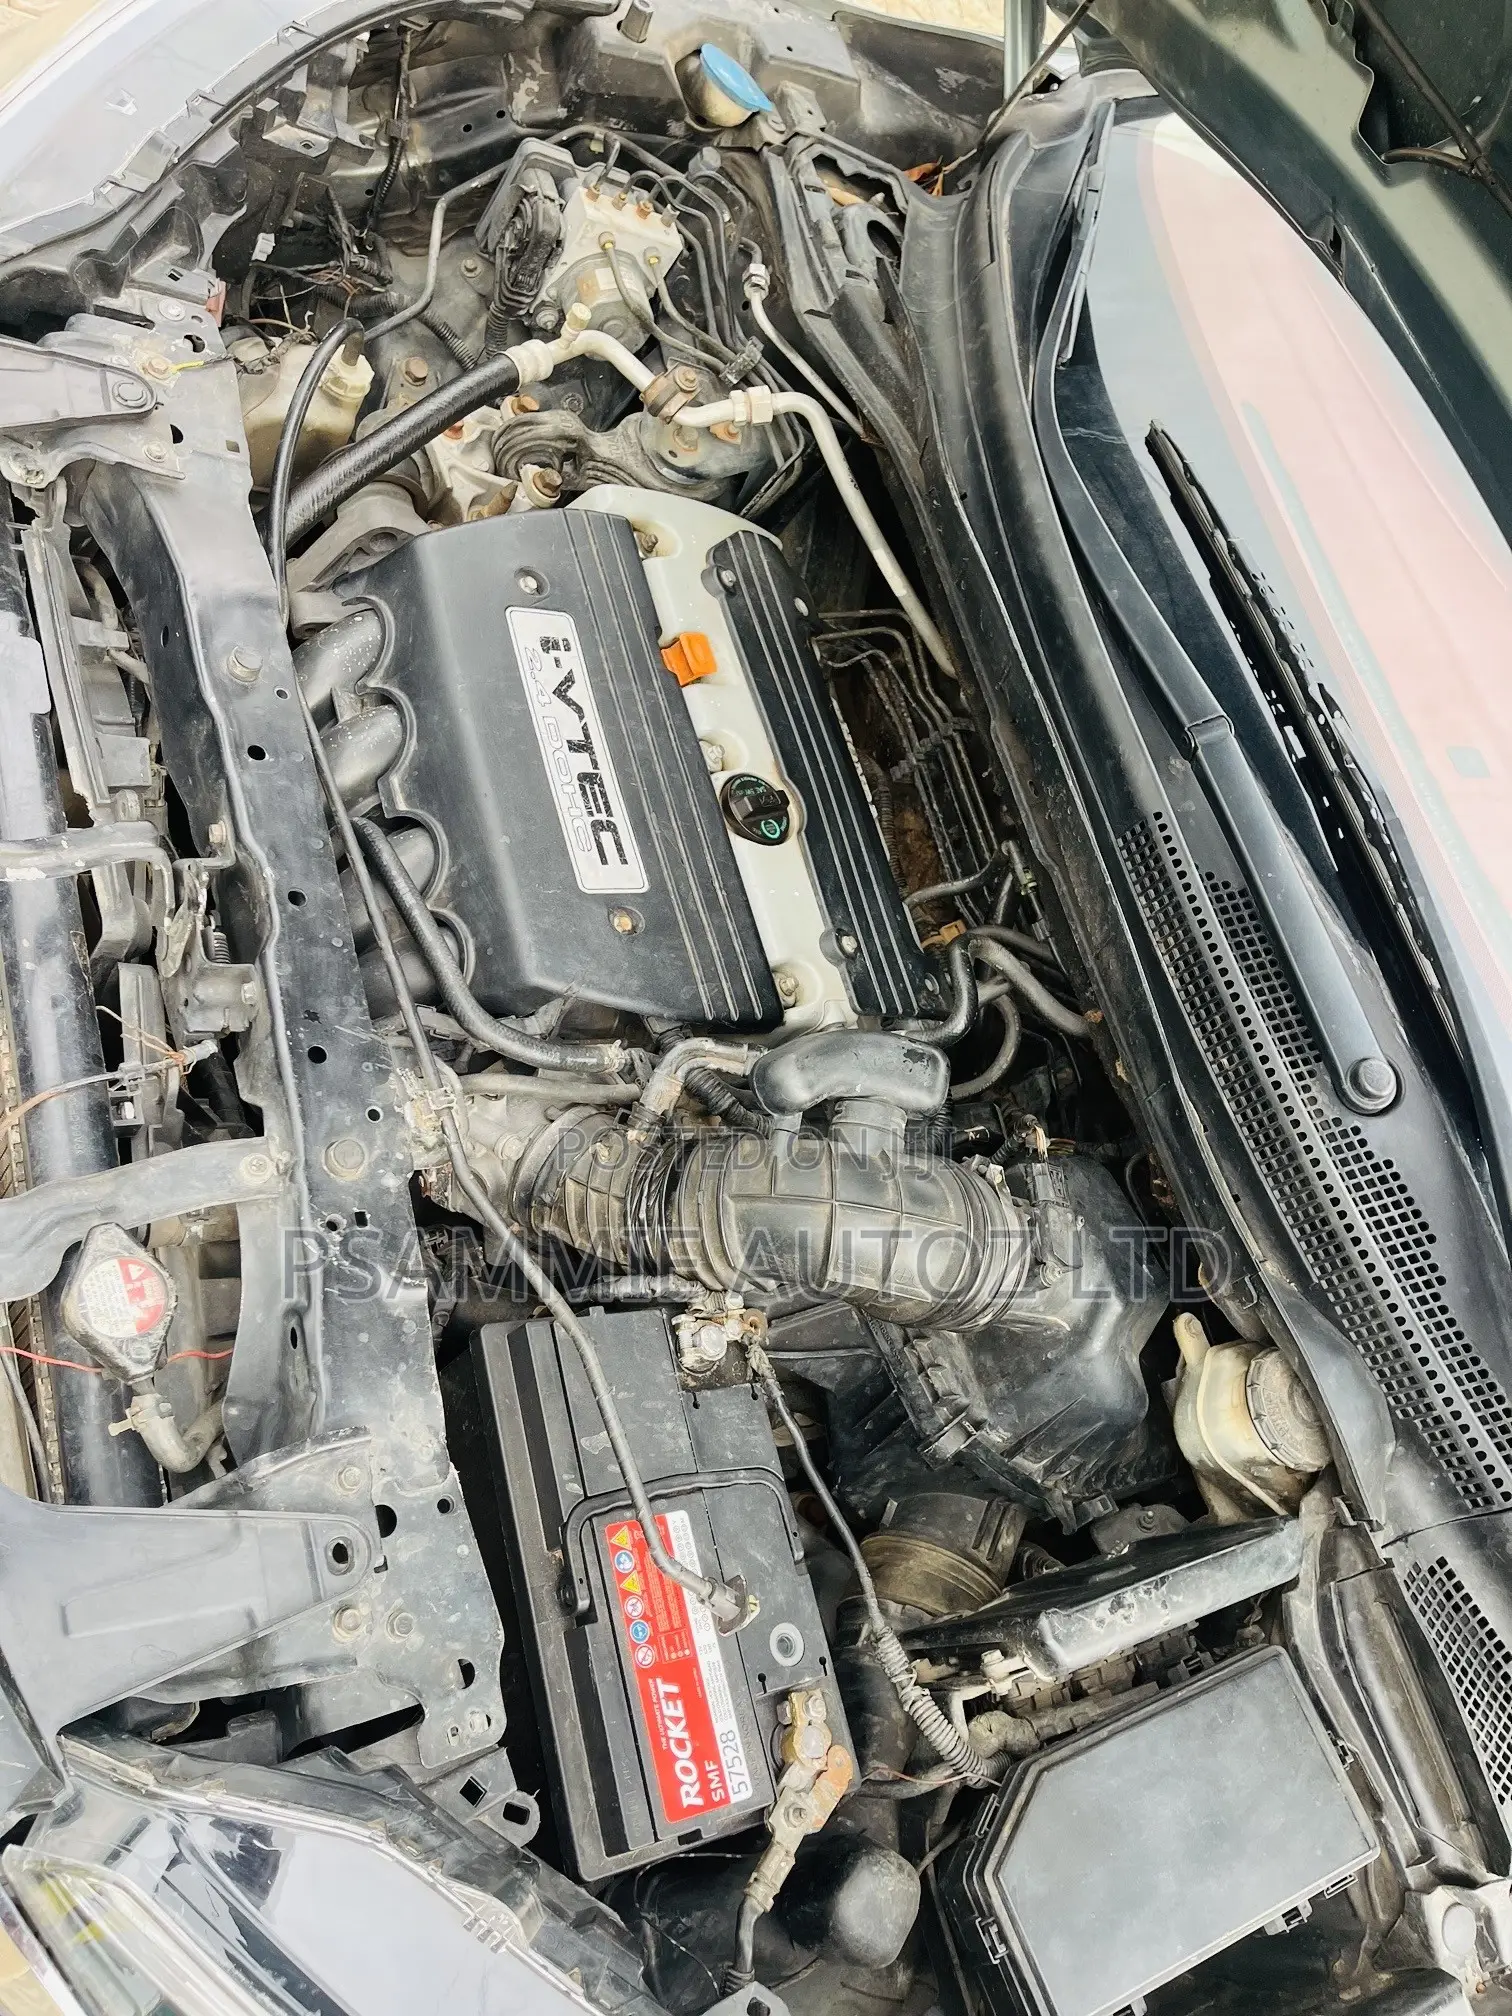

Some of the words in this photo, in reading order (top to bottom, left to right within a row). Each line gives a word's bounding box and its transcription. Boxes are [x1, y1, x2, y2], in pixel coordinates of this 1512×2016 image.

[524, 646, 553, 707] 2.4
[541, 716, 594, 853] DOHC
[539, 636, 629, 866] i-VTEC
[648, 1677, 659, 1704] POWER
[653, 1704, 665, 1736] ULTIMATE
[655, 1676, 706, 1809] ROCKET
[660, 1735, 668, 1750] THE
[704, 1759, 725, 1803] SMF
[719, 1729, 749, 1795] 57528
